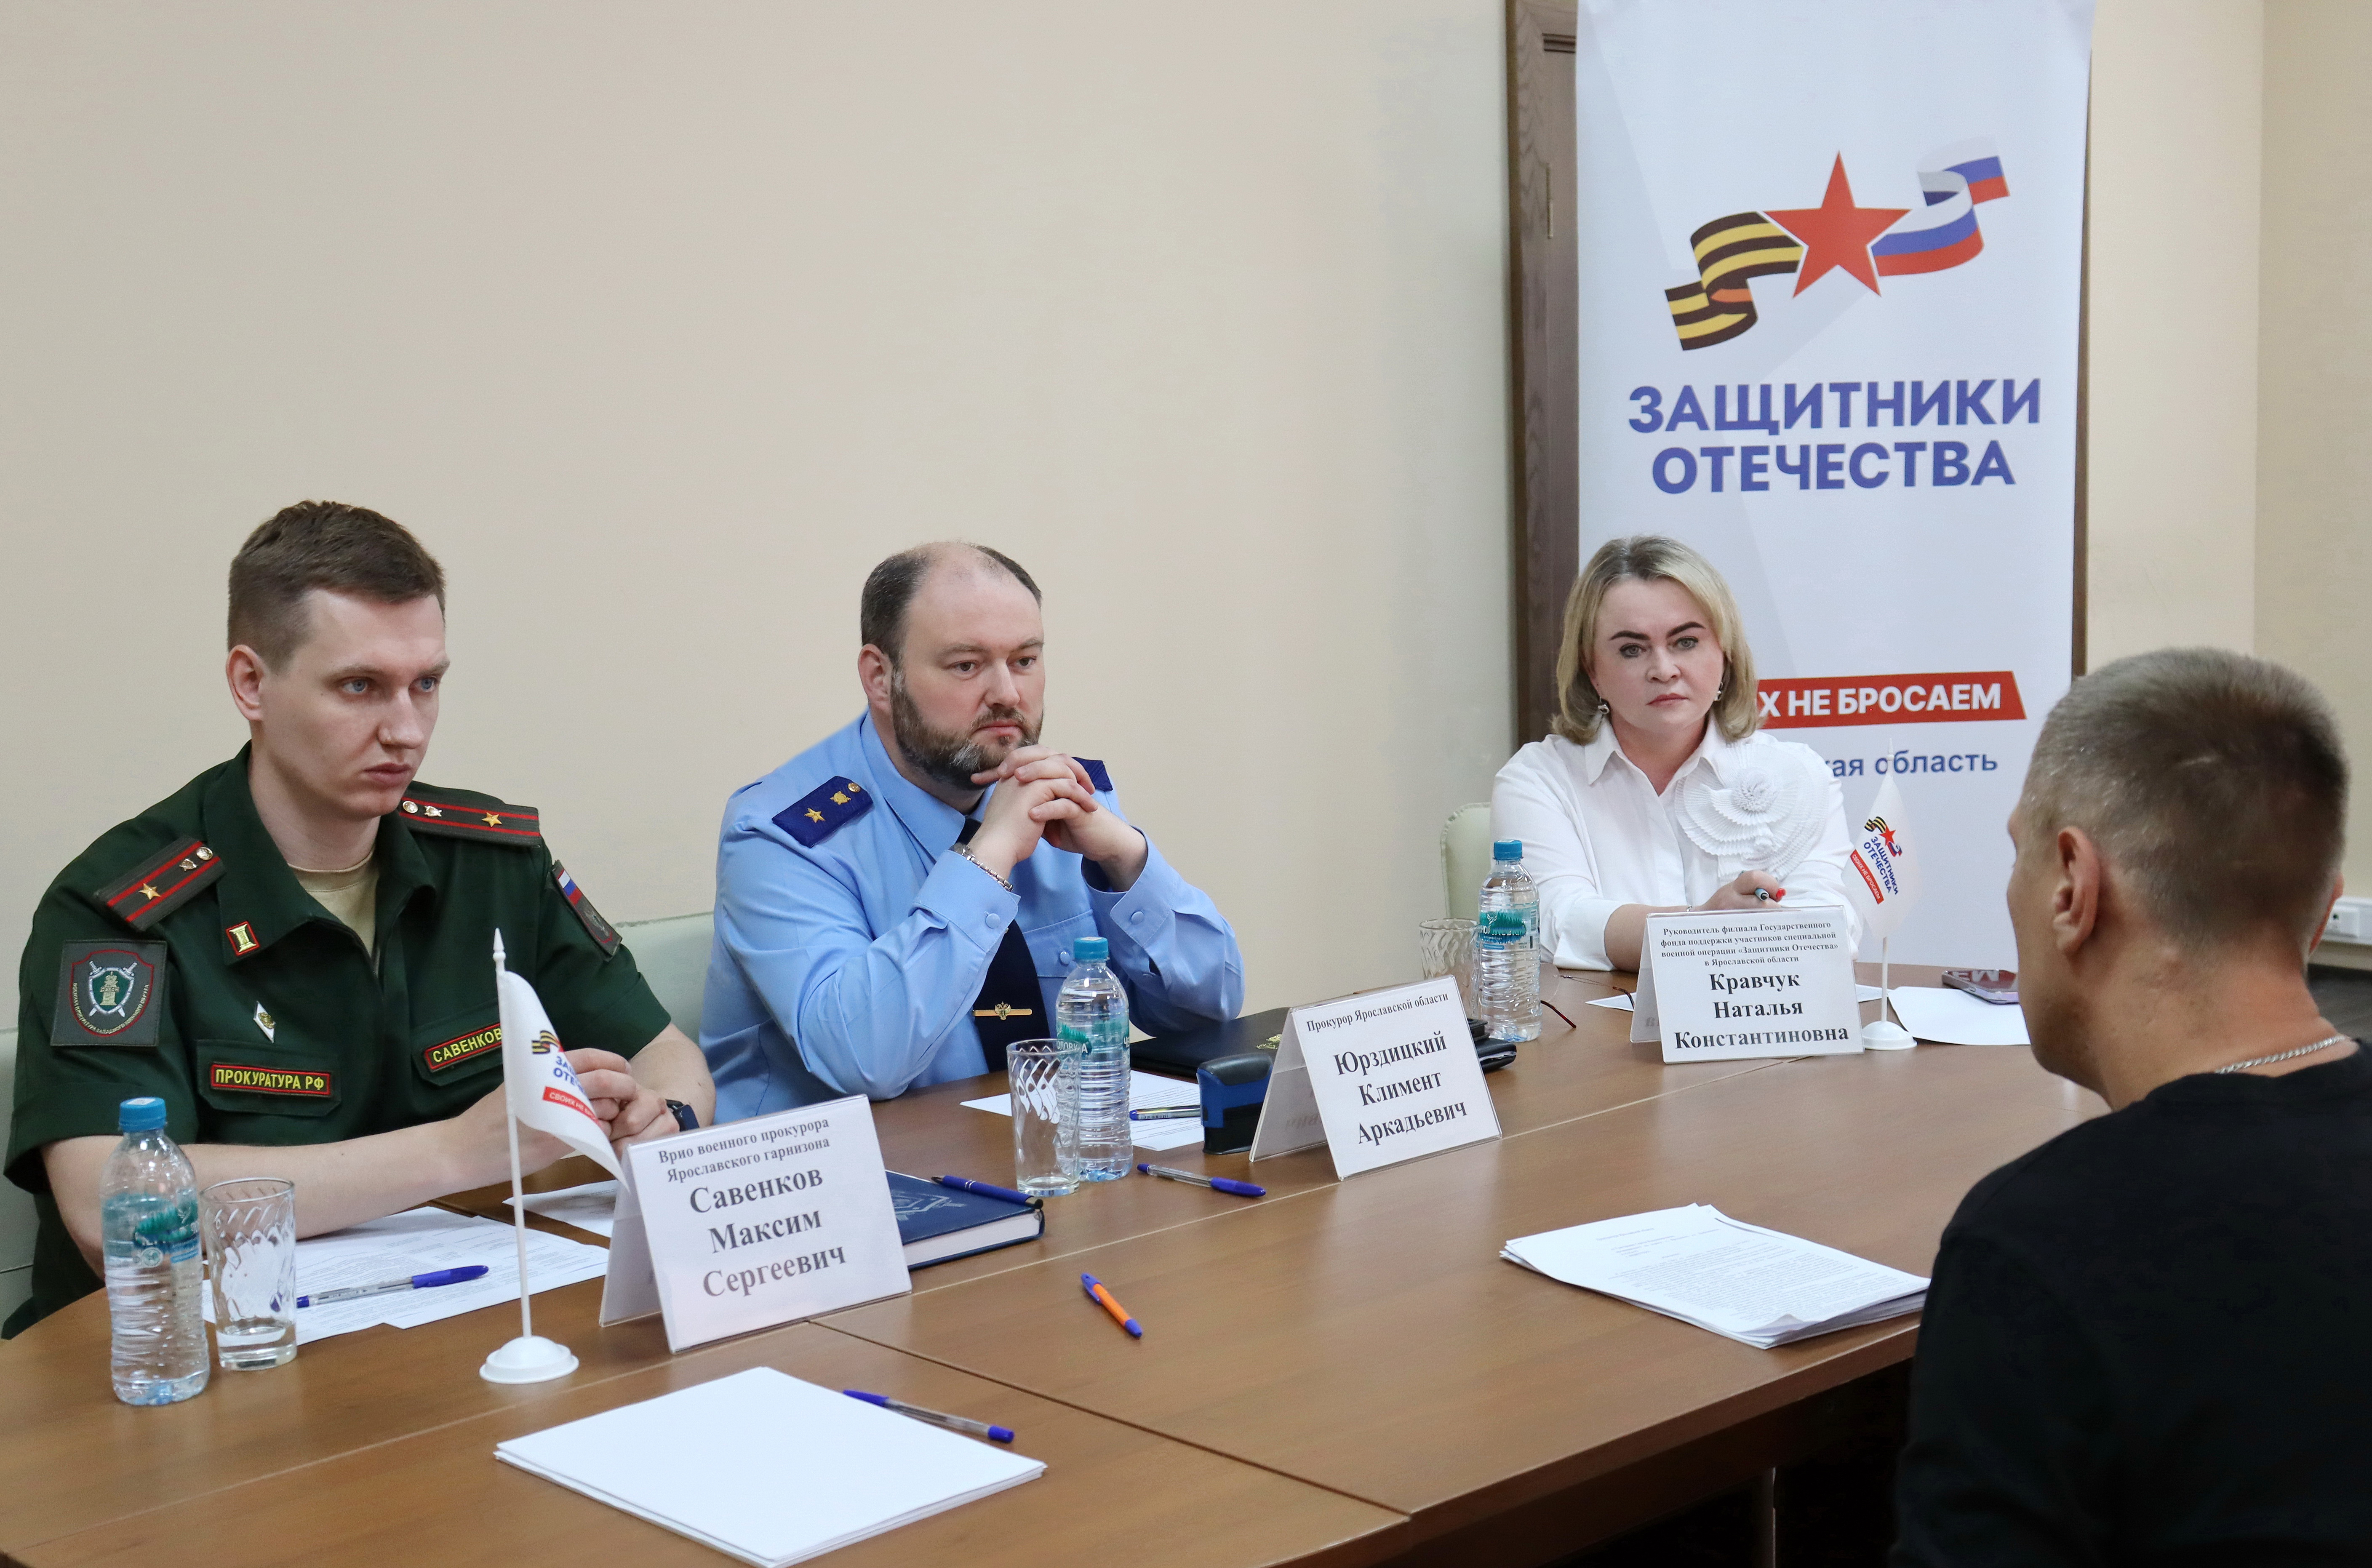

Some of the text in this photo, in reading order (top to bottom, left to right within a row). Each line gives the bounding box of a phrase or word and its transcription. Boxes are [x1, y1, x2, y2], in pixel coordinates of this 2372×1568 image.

[1628, 378, 2041, 435] ЗАЩИТНИКИ
[1652, 440, 2016, 494] ОТЕЧЕСТВА
[1788, 689, 1831, 716] НЕ
[1838, 683, 2001, 715] БРОСАЕМ
[1875, 750, 1998, 774] область
[1852, 854, 1864, 870] СВОИХ
[1865, 874, 1881, 900] БРОСАЕМ
[1864, 842, 1892, 893] ОТЕЧЕСТВА
[1871, 836, 1899, 895] ЗАЩИТНИКИ
[1661, 931, 1836, 948] фонда поддержки участников специальной
[1663, 922, 1831, 936] Руководитель филиала Государственного
[1661, 943, 1838, 957] военной операции «Защитники Отечества»
[1711, 956, 1765, 967] Ярославской
[1767, 955, 1799, 963] области
[1709, 973, 1801, 995] Кравчук
[1306, 992, 1449, 1033] Прокурор Ярославской области
[1713, 1002, 1804, 1019] Наталья
[432, 1028, 502, 1063] САВЕНКОВ
[1333, 1031, 1448, 1076] Юрздицкий
[1673, 1027, 1849, 1049] Константиновна
[216, 1069, 324, 1091] ПРОКУРАТУРА РФ
[1357, 1072, 1442, 1106] Климент
[549, 1092, 576, 1107] СВОИХ
[658, 1117, 829, 1166] Врио военного прокурора
[1358, 1102, 1467, 1146] Аркадьевич
[667, 1138, 830, 1184] Ярославского гарнизона
[689, 1169, 823, 1214] Савенков
[708, 1211, 822, 1254] Максим
[703, 1246, 847, 1298] Сергеевич
